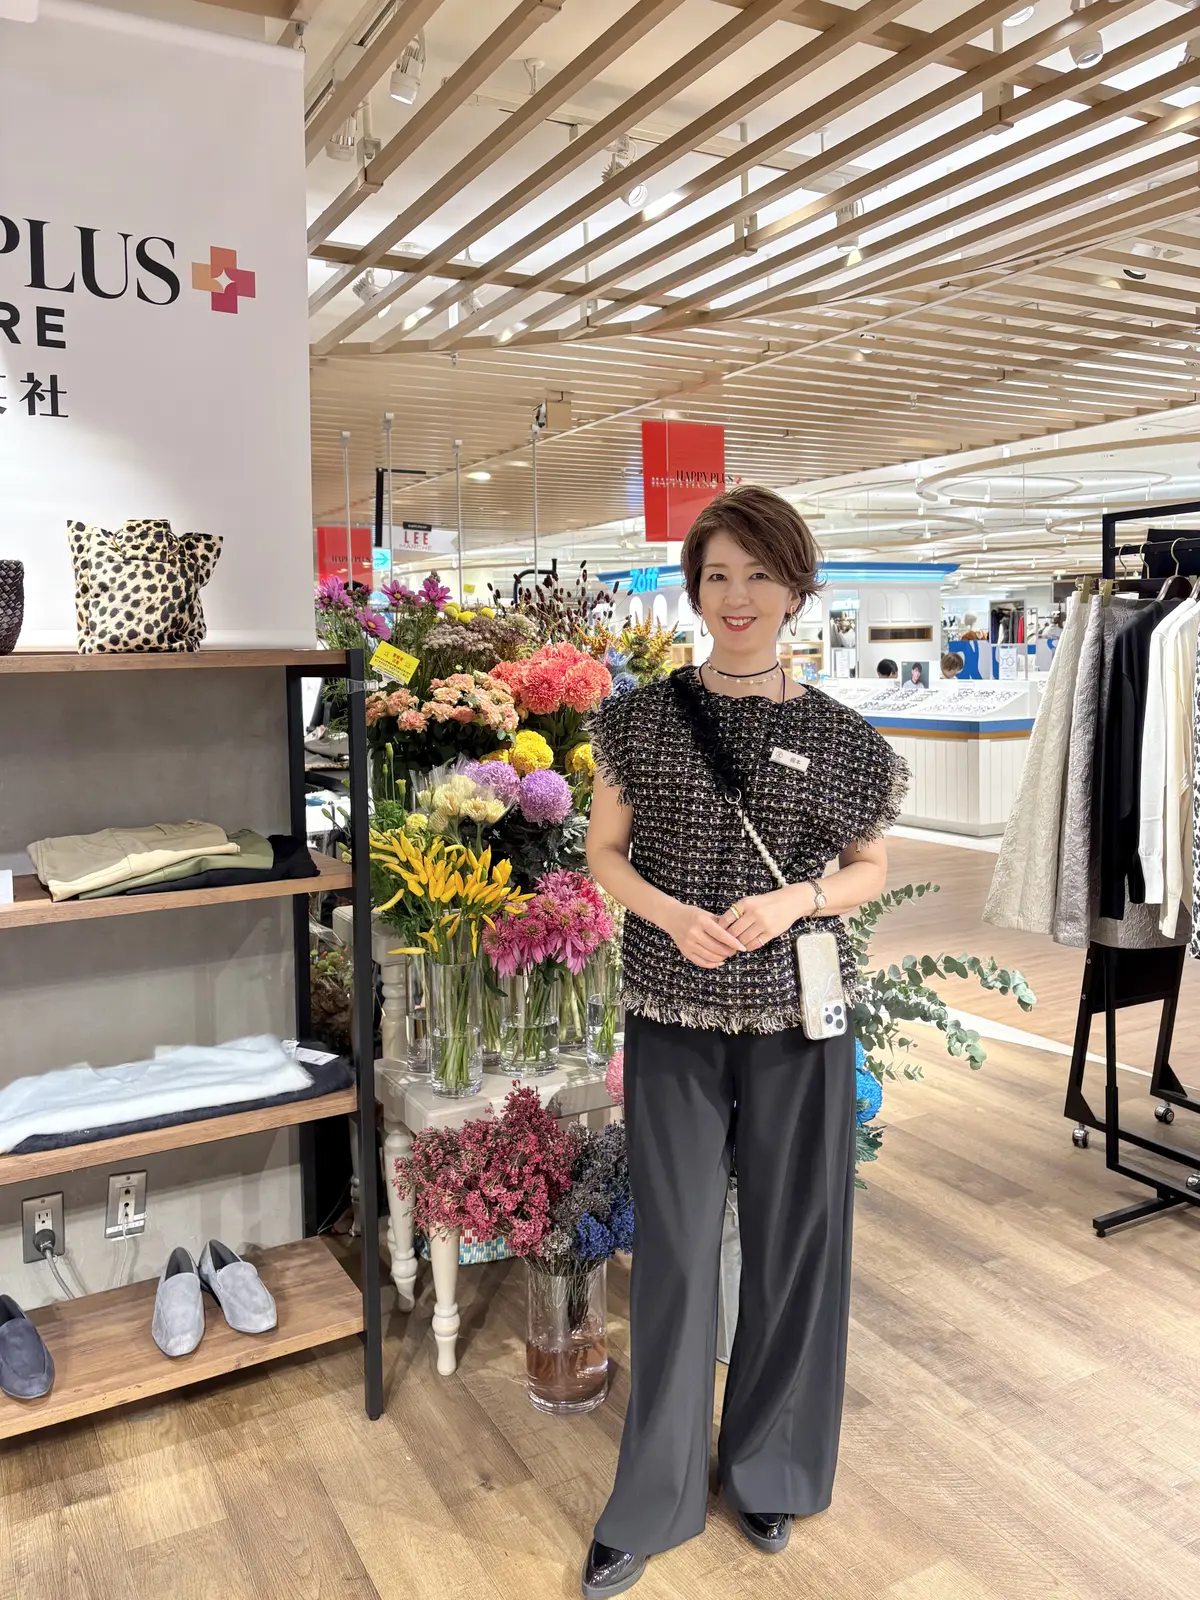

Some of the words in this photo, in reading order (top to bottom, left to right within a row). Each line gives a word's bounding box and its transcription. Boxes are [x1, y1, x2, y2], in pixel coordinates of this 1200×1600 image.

[0, 371, 69, 418] 社
[676, 470, 708, 483] HAPPY
[405, 531, 428, 545] LEE
[629, 567, 659, 593] Zoff
